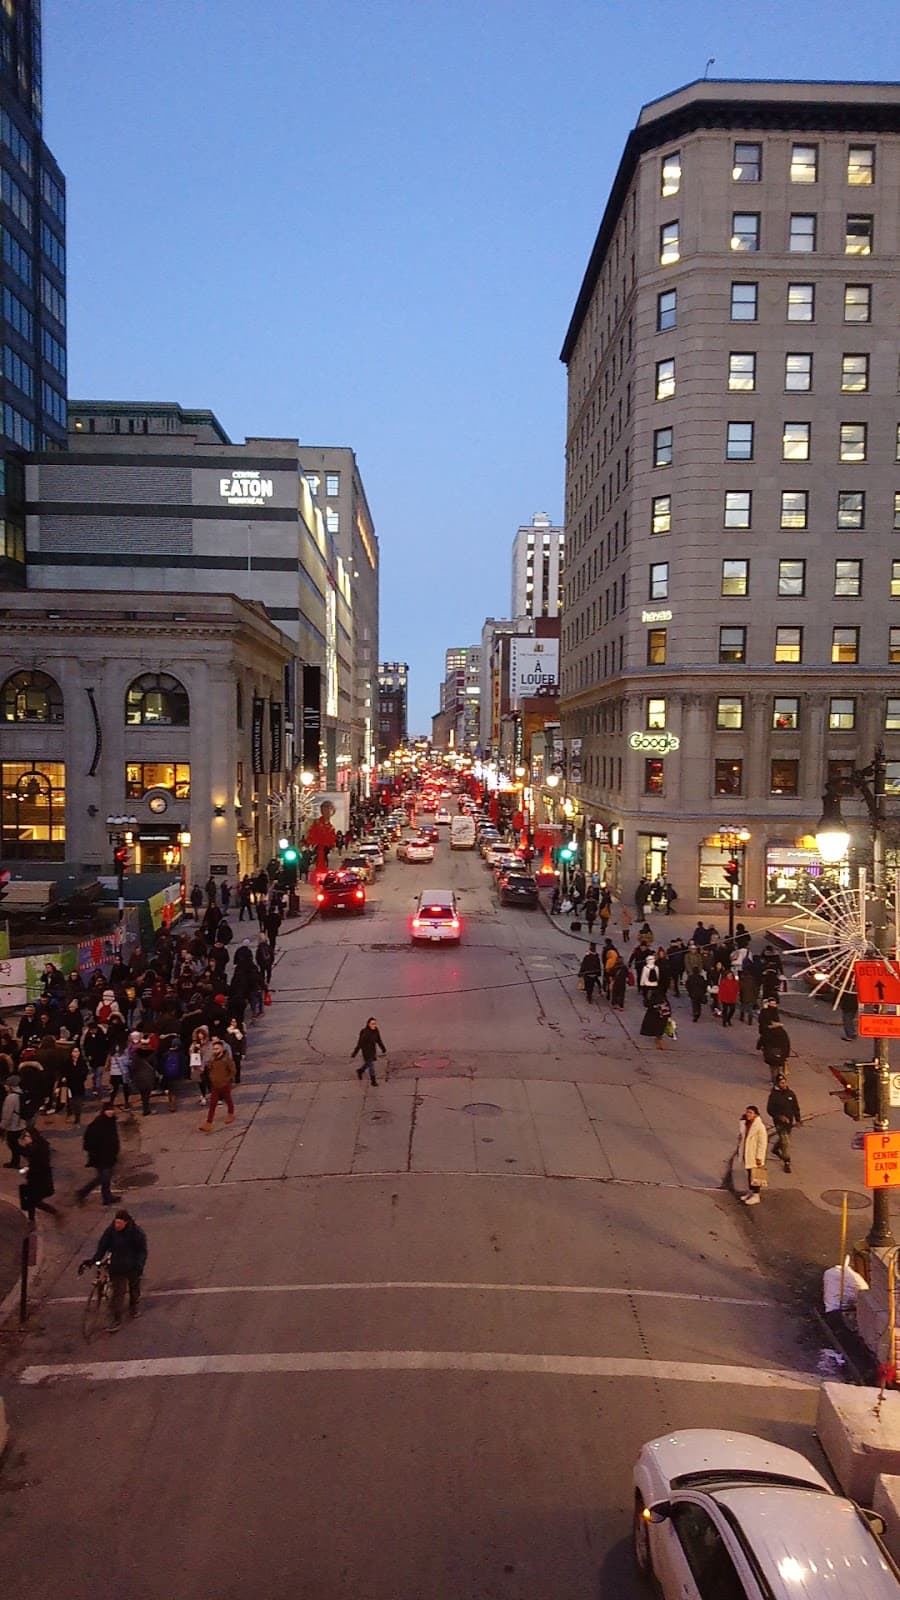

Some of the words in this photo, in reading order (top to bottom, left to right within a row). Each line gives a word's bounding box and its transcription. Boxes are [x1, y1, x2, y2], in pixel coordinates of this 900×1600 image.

[220, 479, 273, 497] EATON
[534, 660, 543, 672] À
[304, 707, 320, 728] GAP
[629, 732, 680, 755] Google
[882, 1136, 890, 1148] P
[873, 1151, 899, 1160] CENTRE
[874, 1161, 897, 1171] EATON
